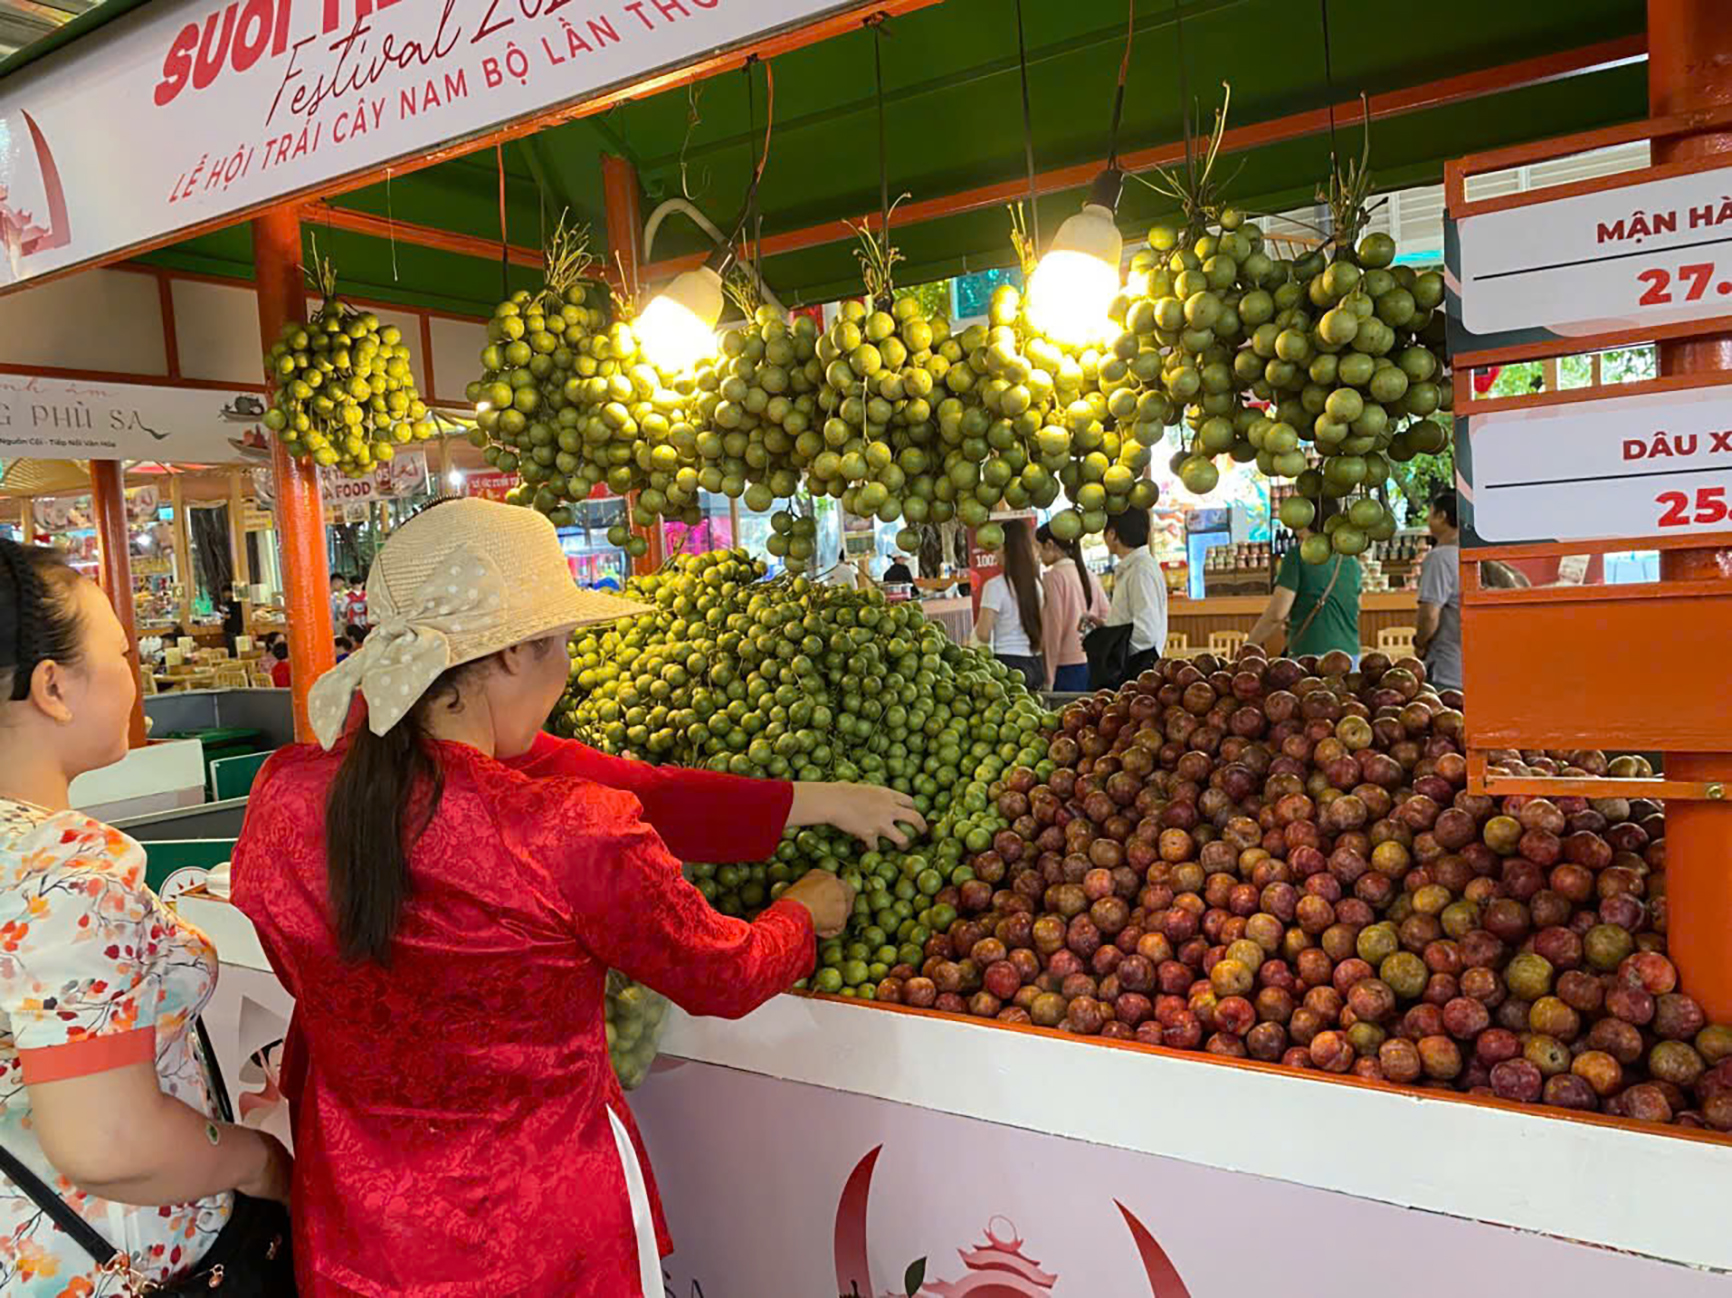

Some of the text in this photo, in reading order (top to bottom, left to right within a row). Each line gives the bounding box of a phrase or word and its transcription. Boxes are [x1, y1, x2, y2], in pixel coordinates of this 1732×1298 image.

[266, 0, 461, 127] Festival
[168, 153, 209, 203] LỄ
[204, 144, 254, 191] HỘI
[262, 118, 322, 171] TRÁI
[333, 97, 386, 144] CÂY
[400, 68, 468, 120] NAM
[482, 41, 529, 89] BỘ
[541, 15, 621, 66] LẦN
[1597, 210, 1677, 244] MẬN
[31, 400, 93, 429] PHÙ
[109, 409, 171, 440] SA
[1622, 431, 1697, 461] DÂU
[335, 481, 372, 499] FOOD
